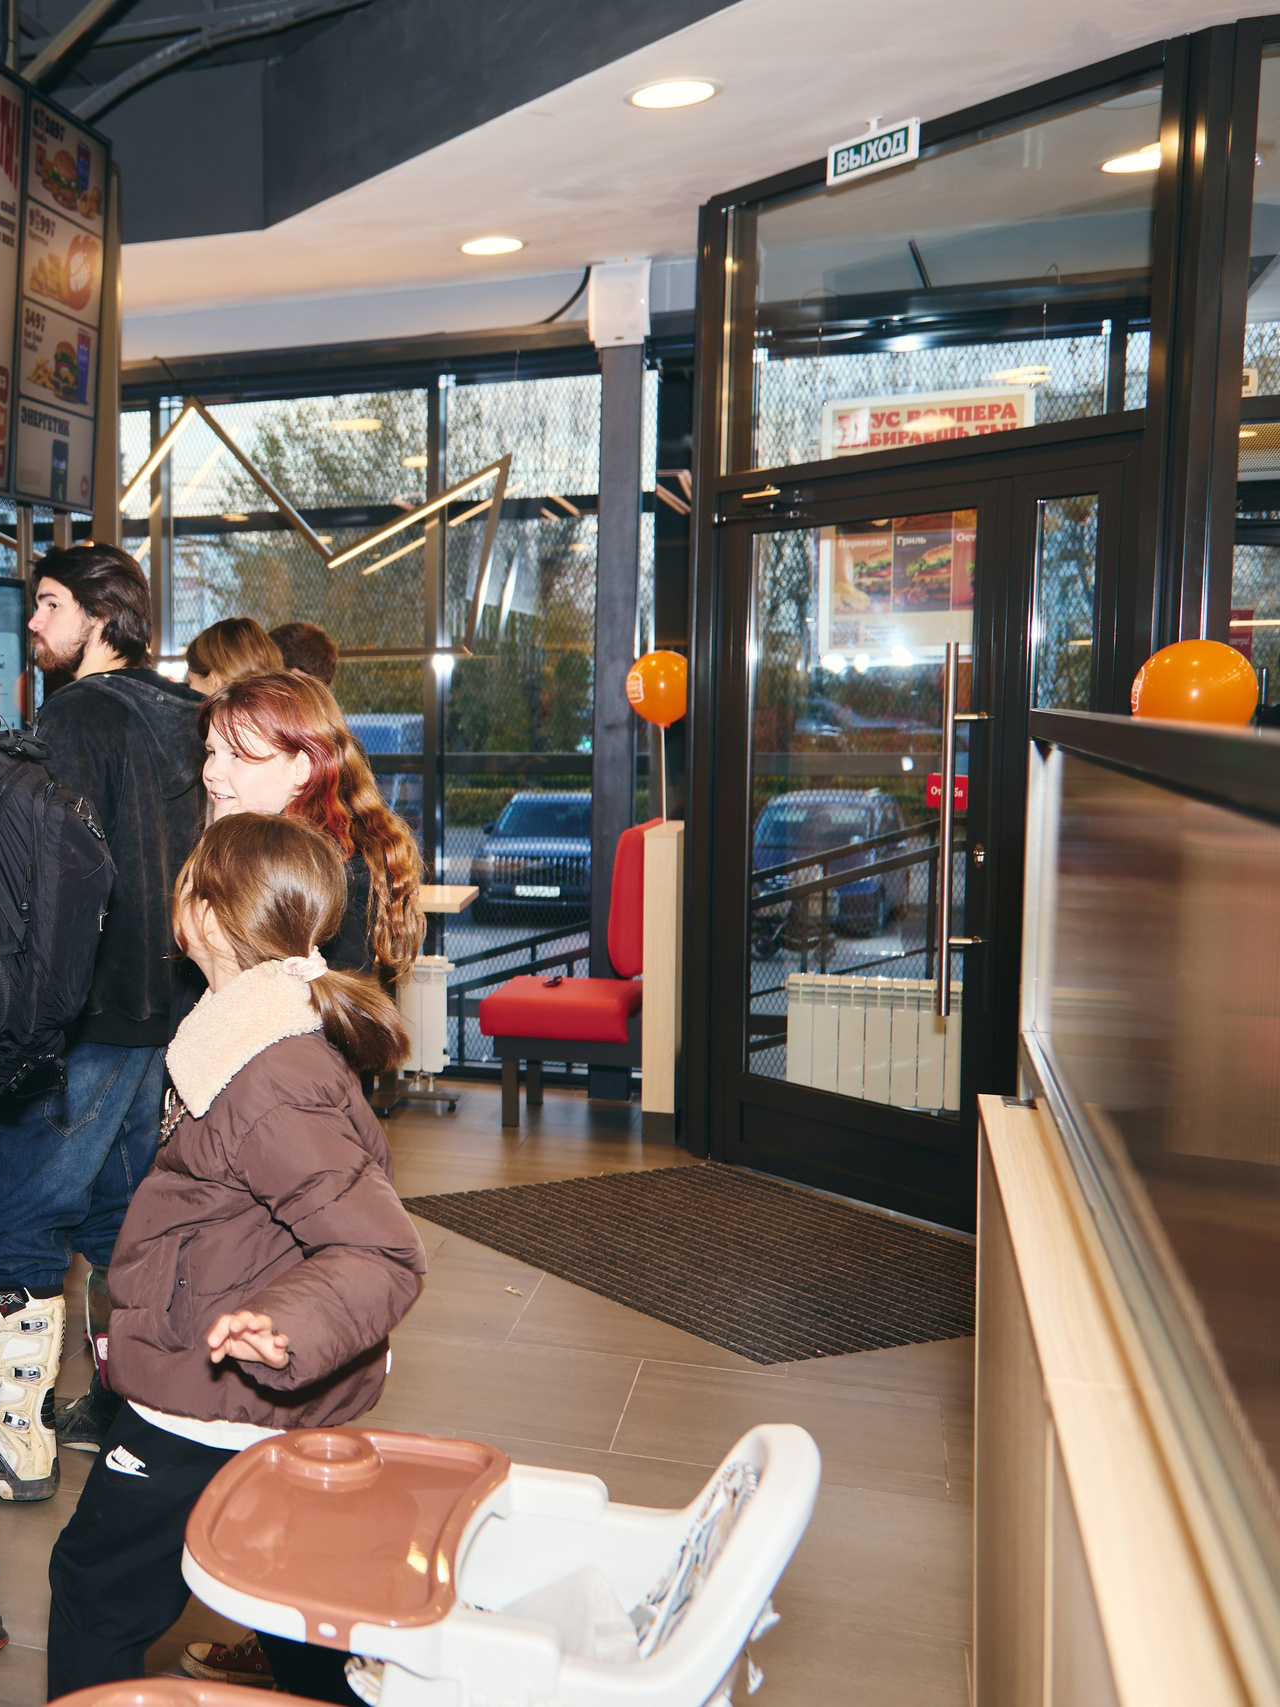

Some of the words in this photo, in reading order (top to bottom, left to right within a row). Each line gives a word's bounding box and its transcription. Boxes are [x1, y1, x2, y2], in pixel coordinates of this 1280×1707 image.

[836, 130, 907, 174] ВЫХОД
[21, 406, 70, 437] ЭНЕРГЕТИК
[838, 537, 887, 549] Пармезан
[896, 535, 927, 547] Гриль
[112, 1444, 147, 1471] NIKE
